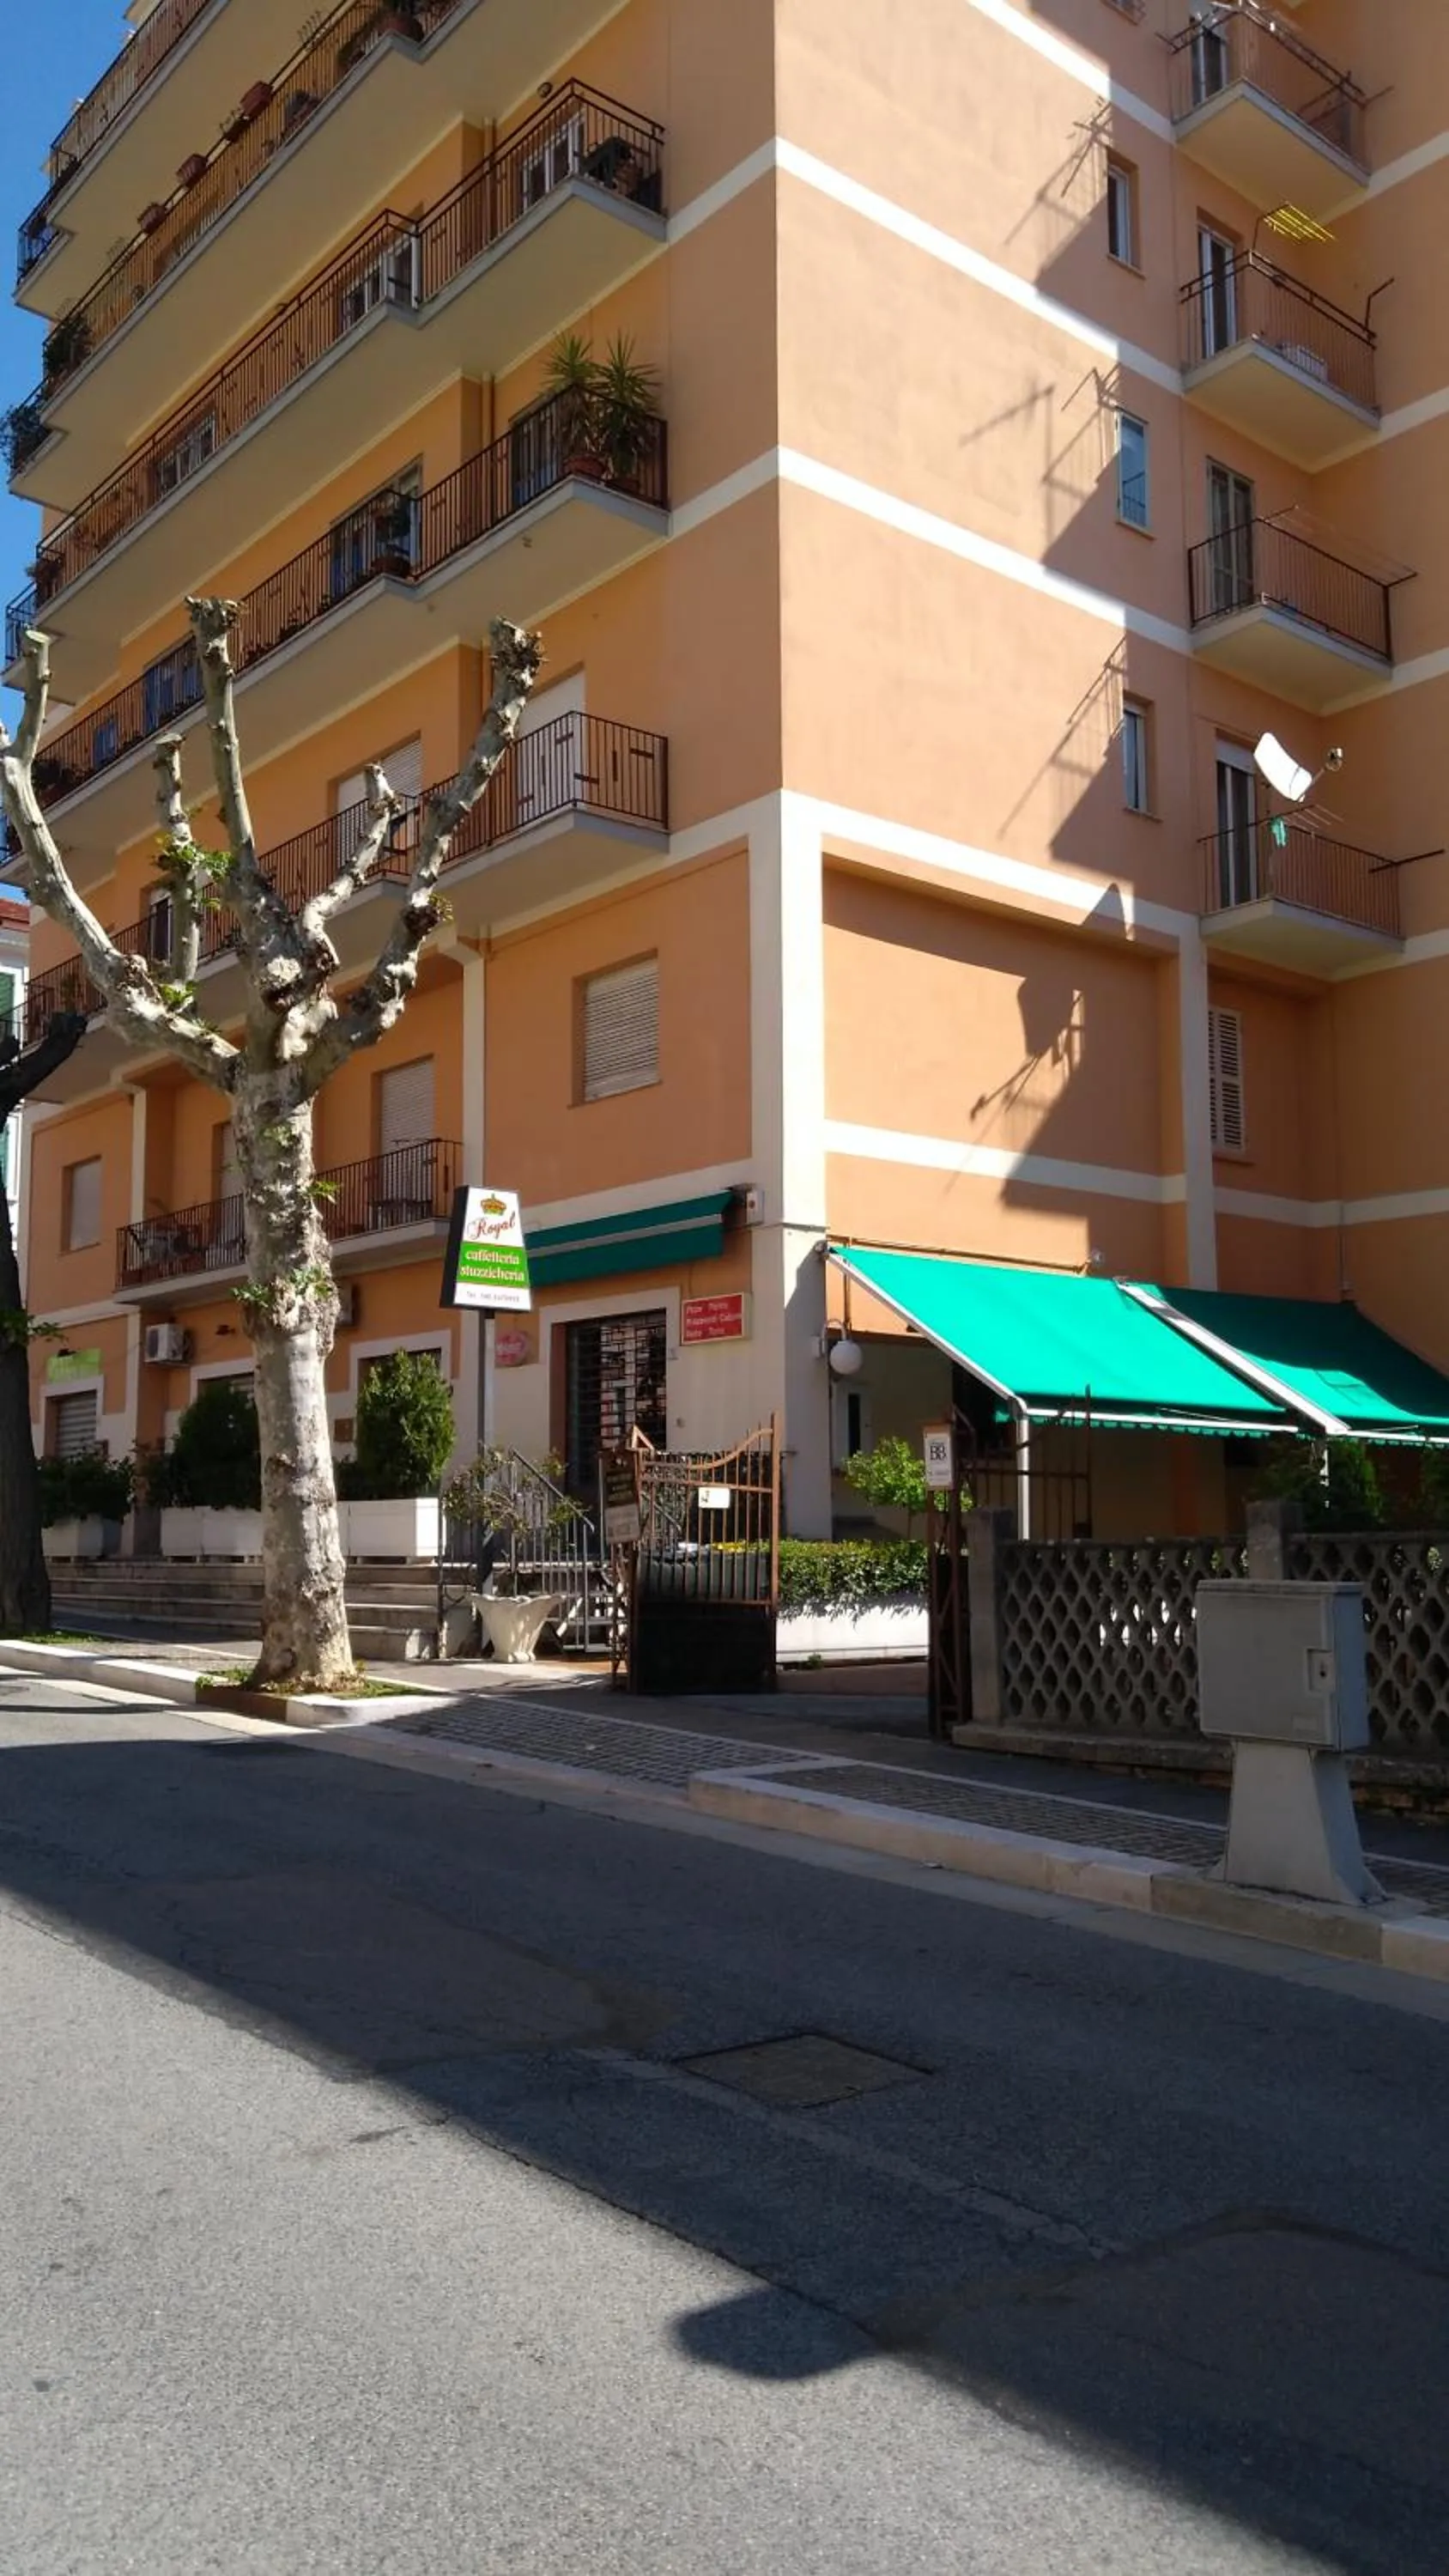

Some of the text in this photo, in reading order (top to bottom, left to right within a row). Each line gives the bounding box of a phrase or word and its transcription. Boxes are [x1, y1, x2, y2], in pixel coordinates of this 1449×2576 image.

[467, 1211, 516, 1240] Royal
[465, 1249, 520, 1265] caffetteria
[459, 1264, 524, 1281] stuzzicheria
